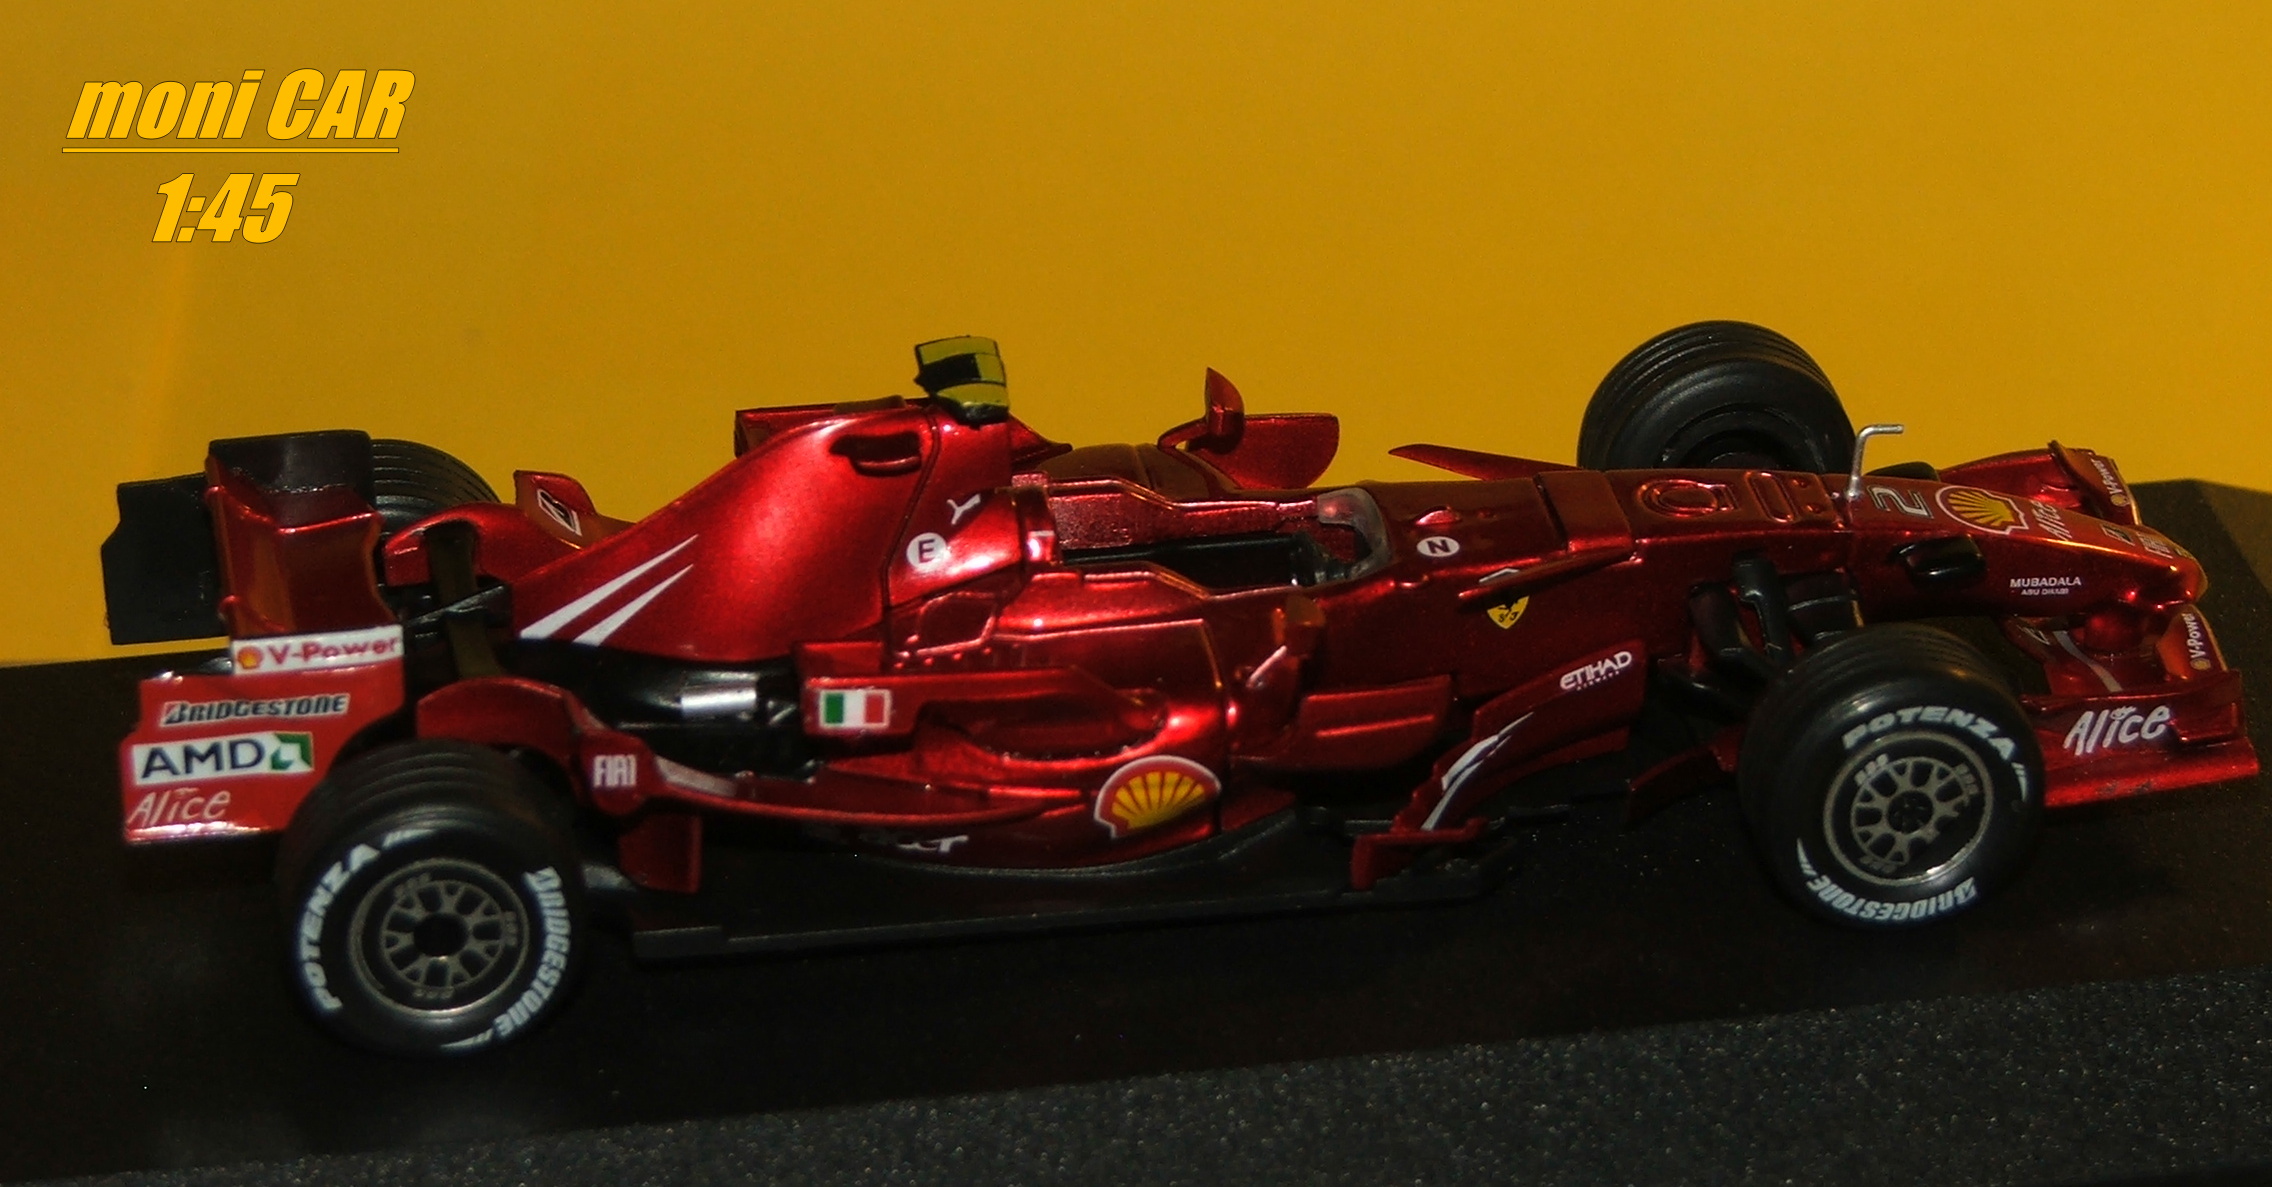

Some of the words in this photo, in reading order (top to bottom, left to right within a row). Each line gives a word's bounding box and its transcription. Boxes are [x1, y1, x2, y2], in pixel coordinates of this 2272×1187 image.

[2009, 576, 2082, 588] MUBADALA
[269, 636, 397, 665] V-Power
[1560, 651, 1632, 690] ETIHAD
[163, 693, 350, 727] BRIDGESTONE
[1841, 705, 2017, 761] POTENZA
[2062, 705, 2172, 757] Alice
[141, 738, 266, 779] AMD
[127, 787, 232, 827] Alice
[1805, 875, 1980, 923] BRIDGESTONE
[299, 843, 381, 1011] POTENZA
[492, 866, 571, 1038] BRIDGESTONE
